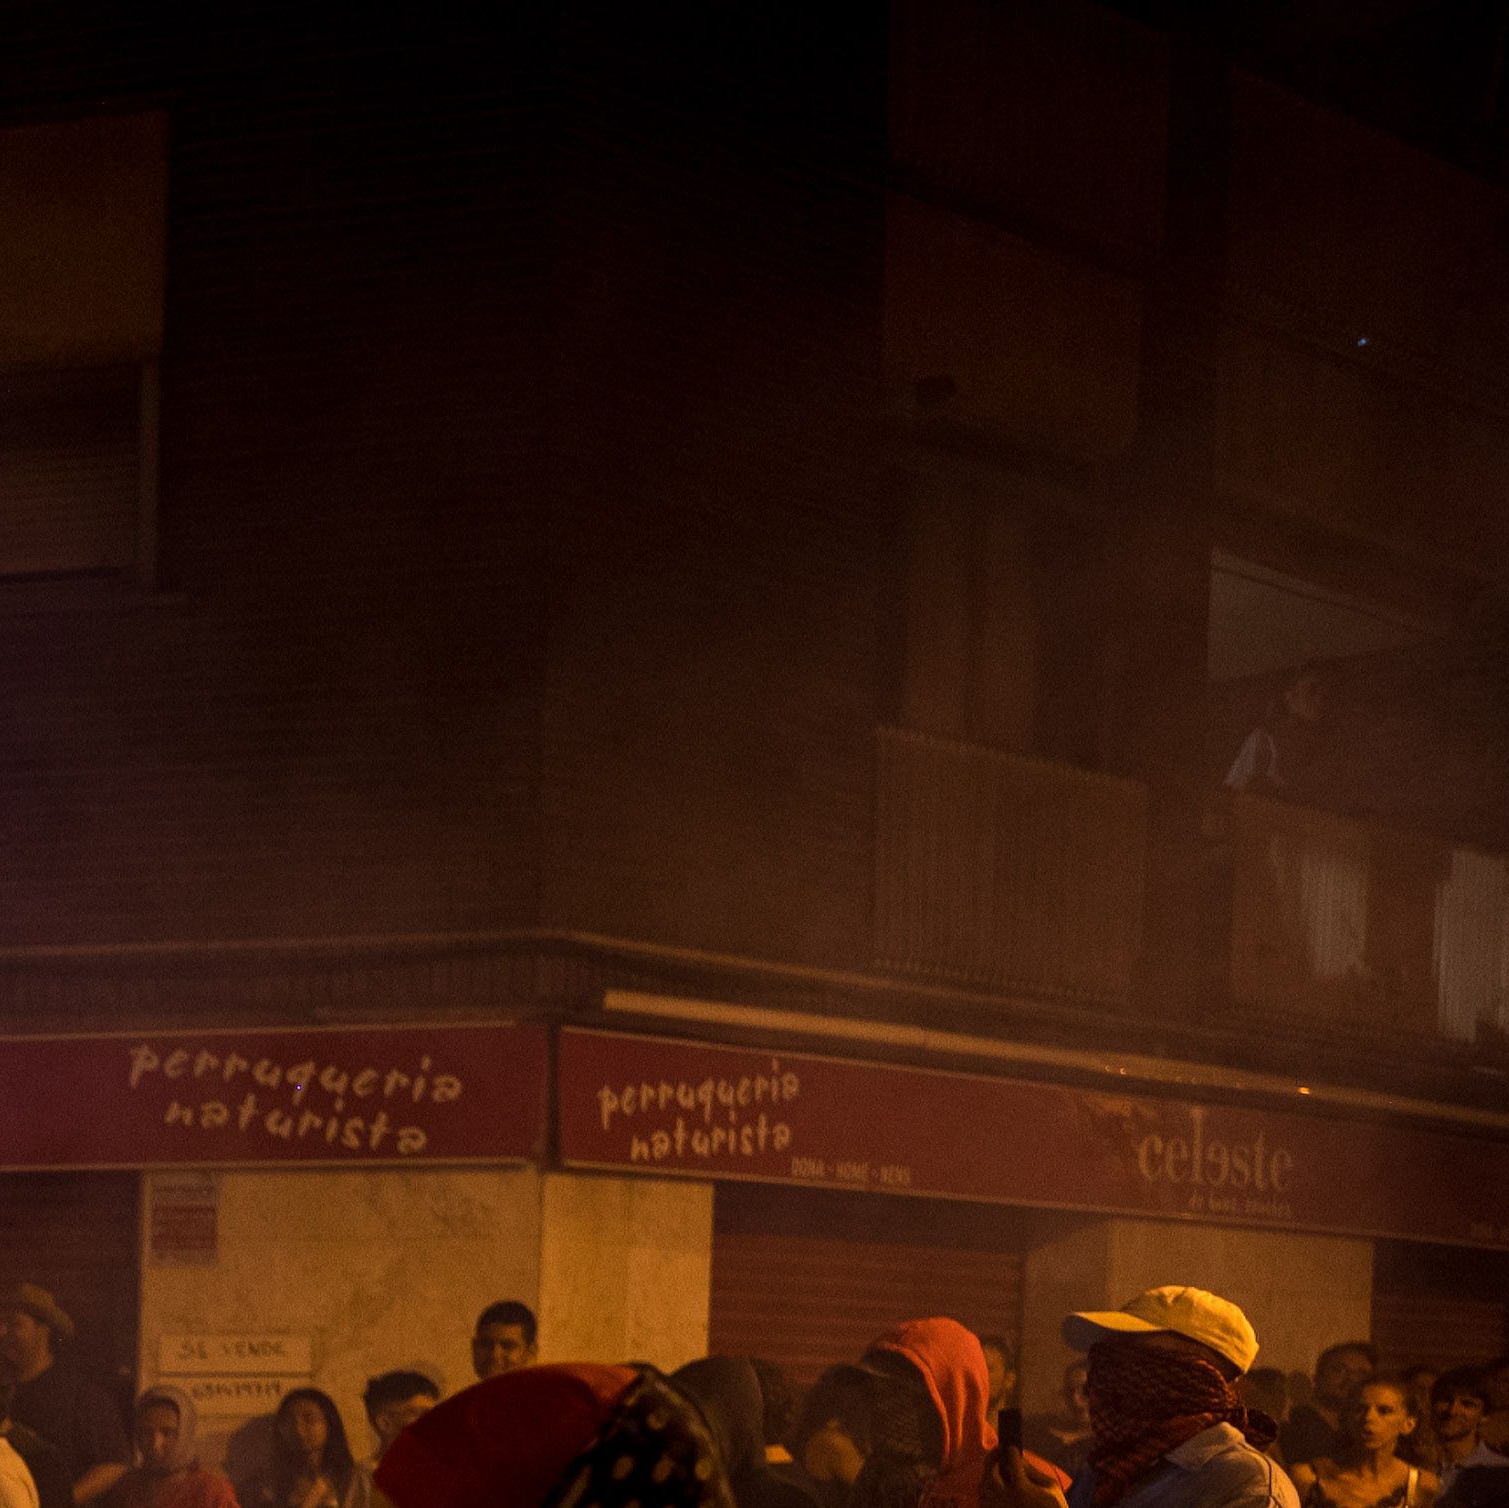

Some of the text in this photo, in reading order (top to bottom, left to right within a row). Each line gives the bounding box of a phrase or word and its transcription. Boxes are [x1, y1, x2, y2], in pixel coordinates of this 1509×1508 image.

[131, 1044, 464, 1106] perruqueria
[597, 1057, 801, 1132] perruqueria
[164, 1092, 429, 1155] naturista
[631, 1109, 791, 1162] naturista
